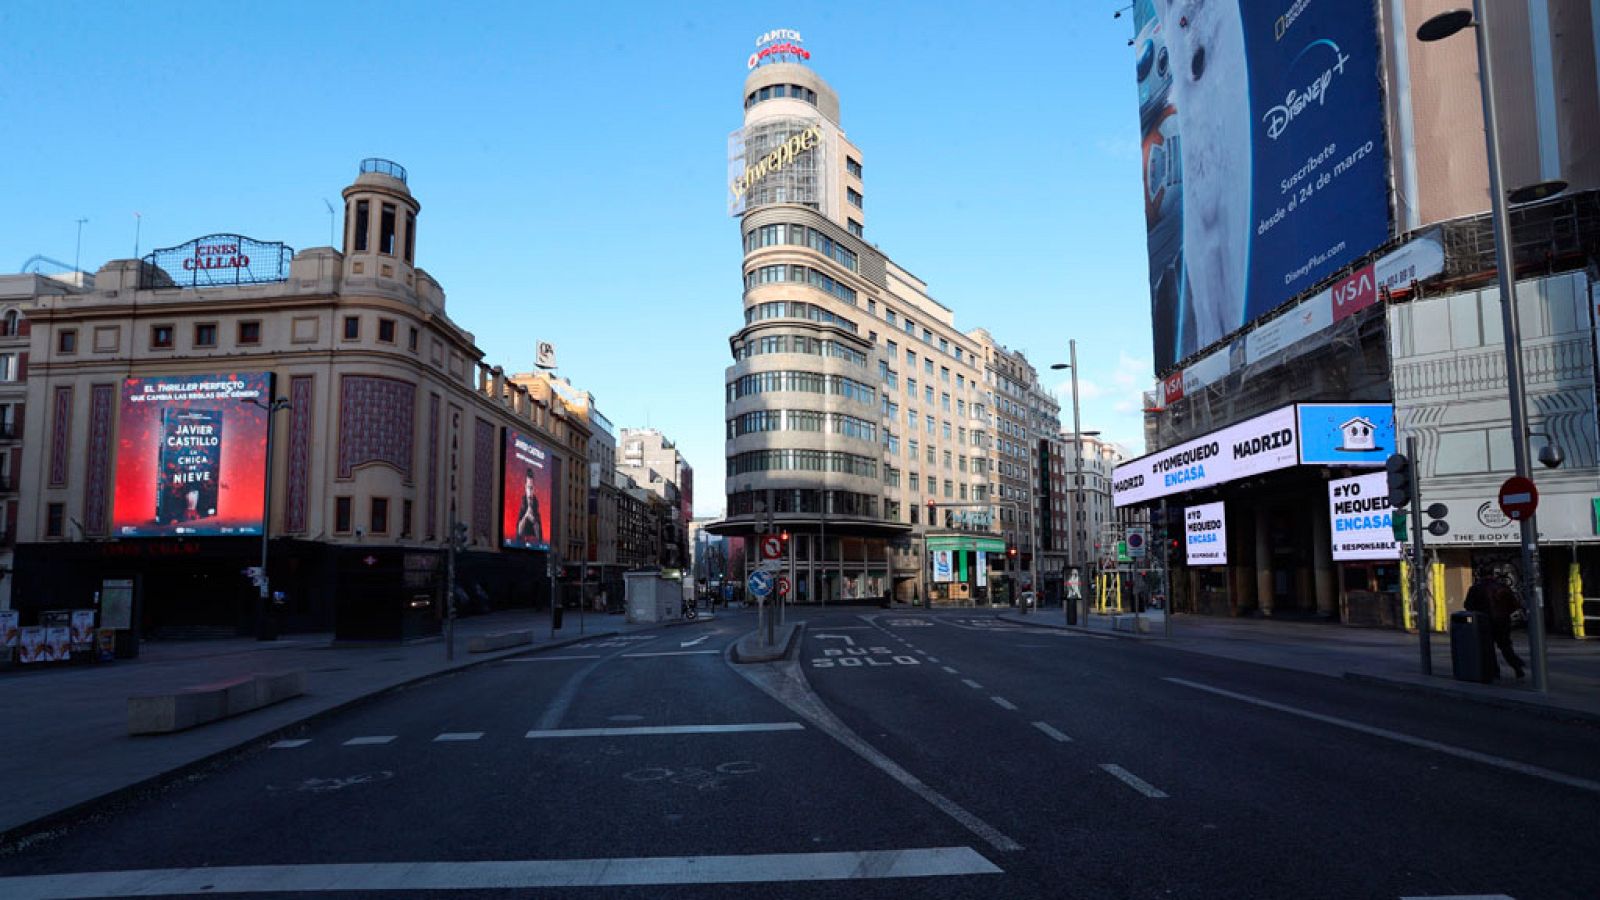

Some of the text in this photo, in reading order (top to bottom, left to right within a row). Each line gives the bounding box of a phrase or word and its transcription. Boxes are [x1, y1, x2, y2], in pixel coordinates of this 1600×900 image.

[756, 29, 803, 46] CAPITOL
[758, 42, 810, 60] vodafone
[730, 126, 823, 201] Schweppes
[1257, 141, 1373, 236] desde el 24 de marzo
[195, 244, 237, 256] CINES
[183, 255, 250, 271] CALLAO
[1285, 241, 1346, 285] DisneyPlus.com
[1335, 274, 1372, 307] VSA
[143, 381, 245, 393] EL THRILLER PERFECTO
[175, 424, 213, 435] JAVIER
[167, 436, 219, 446] CASTILLO
[1233, 428, 1292, 460] MADRID
[178, 456, 208, 465] CHICA
[1153, 441, 1219, 474] #YOMEQUEDO
[173, 471, 211, 484] NIEVE
[1164, 464, 1205, 487] ENCASA
[1113, 474, 1145, 493] MADRID
[1334, 483, 1360, 497] #YO
[1335, 496, 1391, 514] MEQUED
[1187, 511, 1201, 520] #YO
[1336, 514, 1393, 531] ENCASA
[1188, 520, 1222, 532] MEQUEDO
[1188, 533, 1217, 545] ENCASA
[1342, 542, 1396, 551] RESPONSABLE
[824, 647, 892, 655] BUS
[812, 656, 920, 667] SOLO
